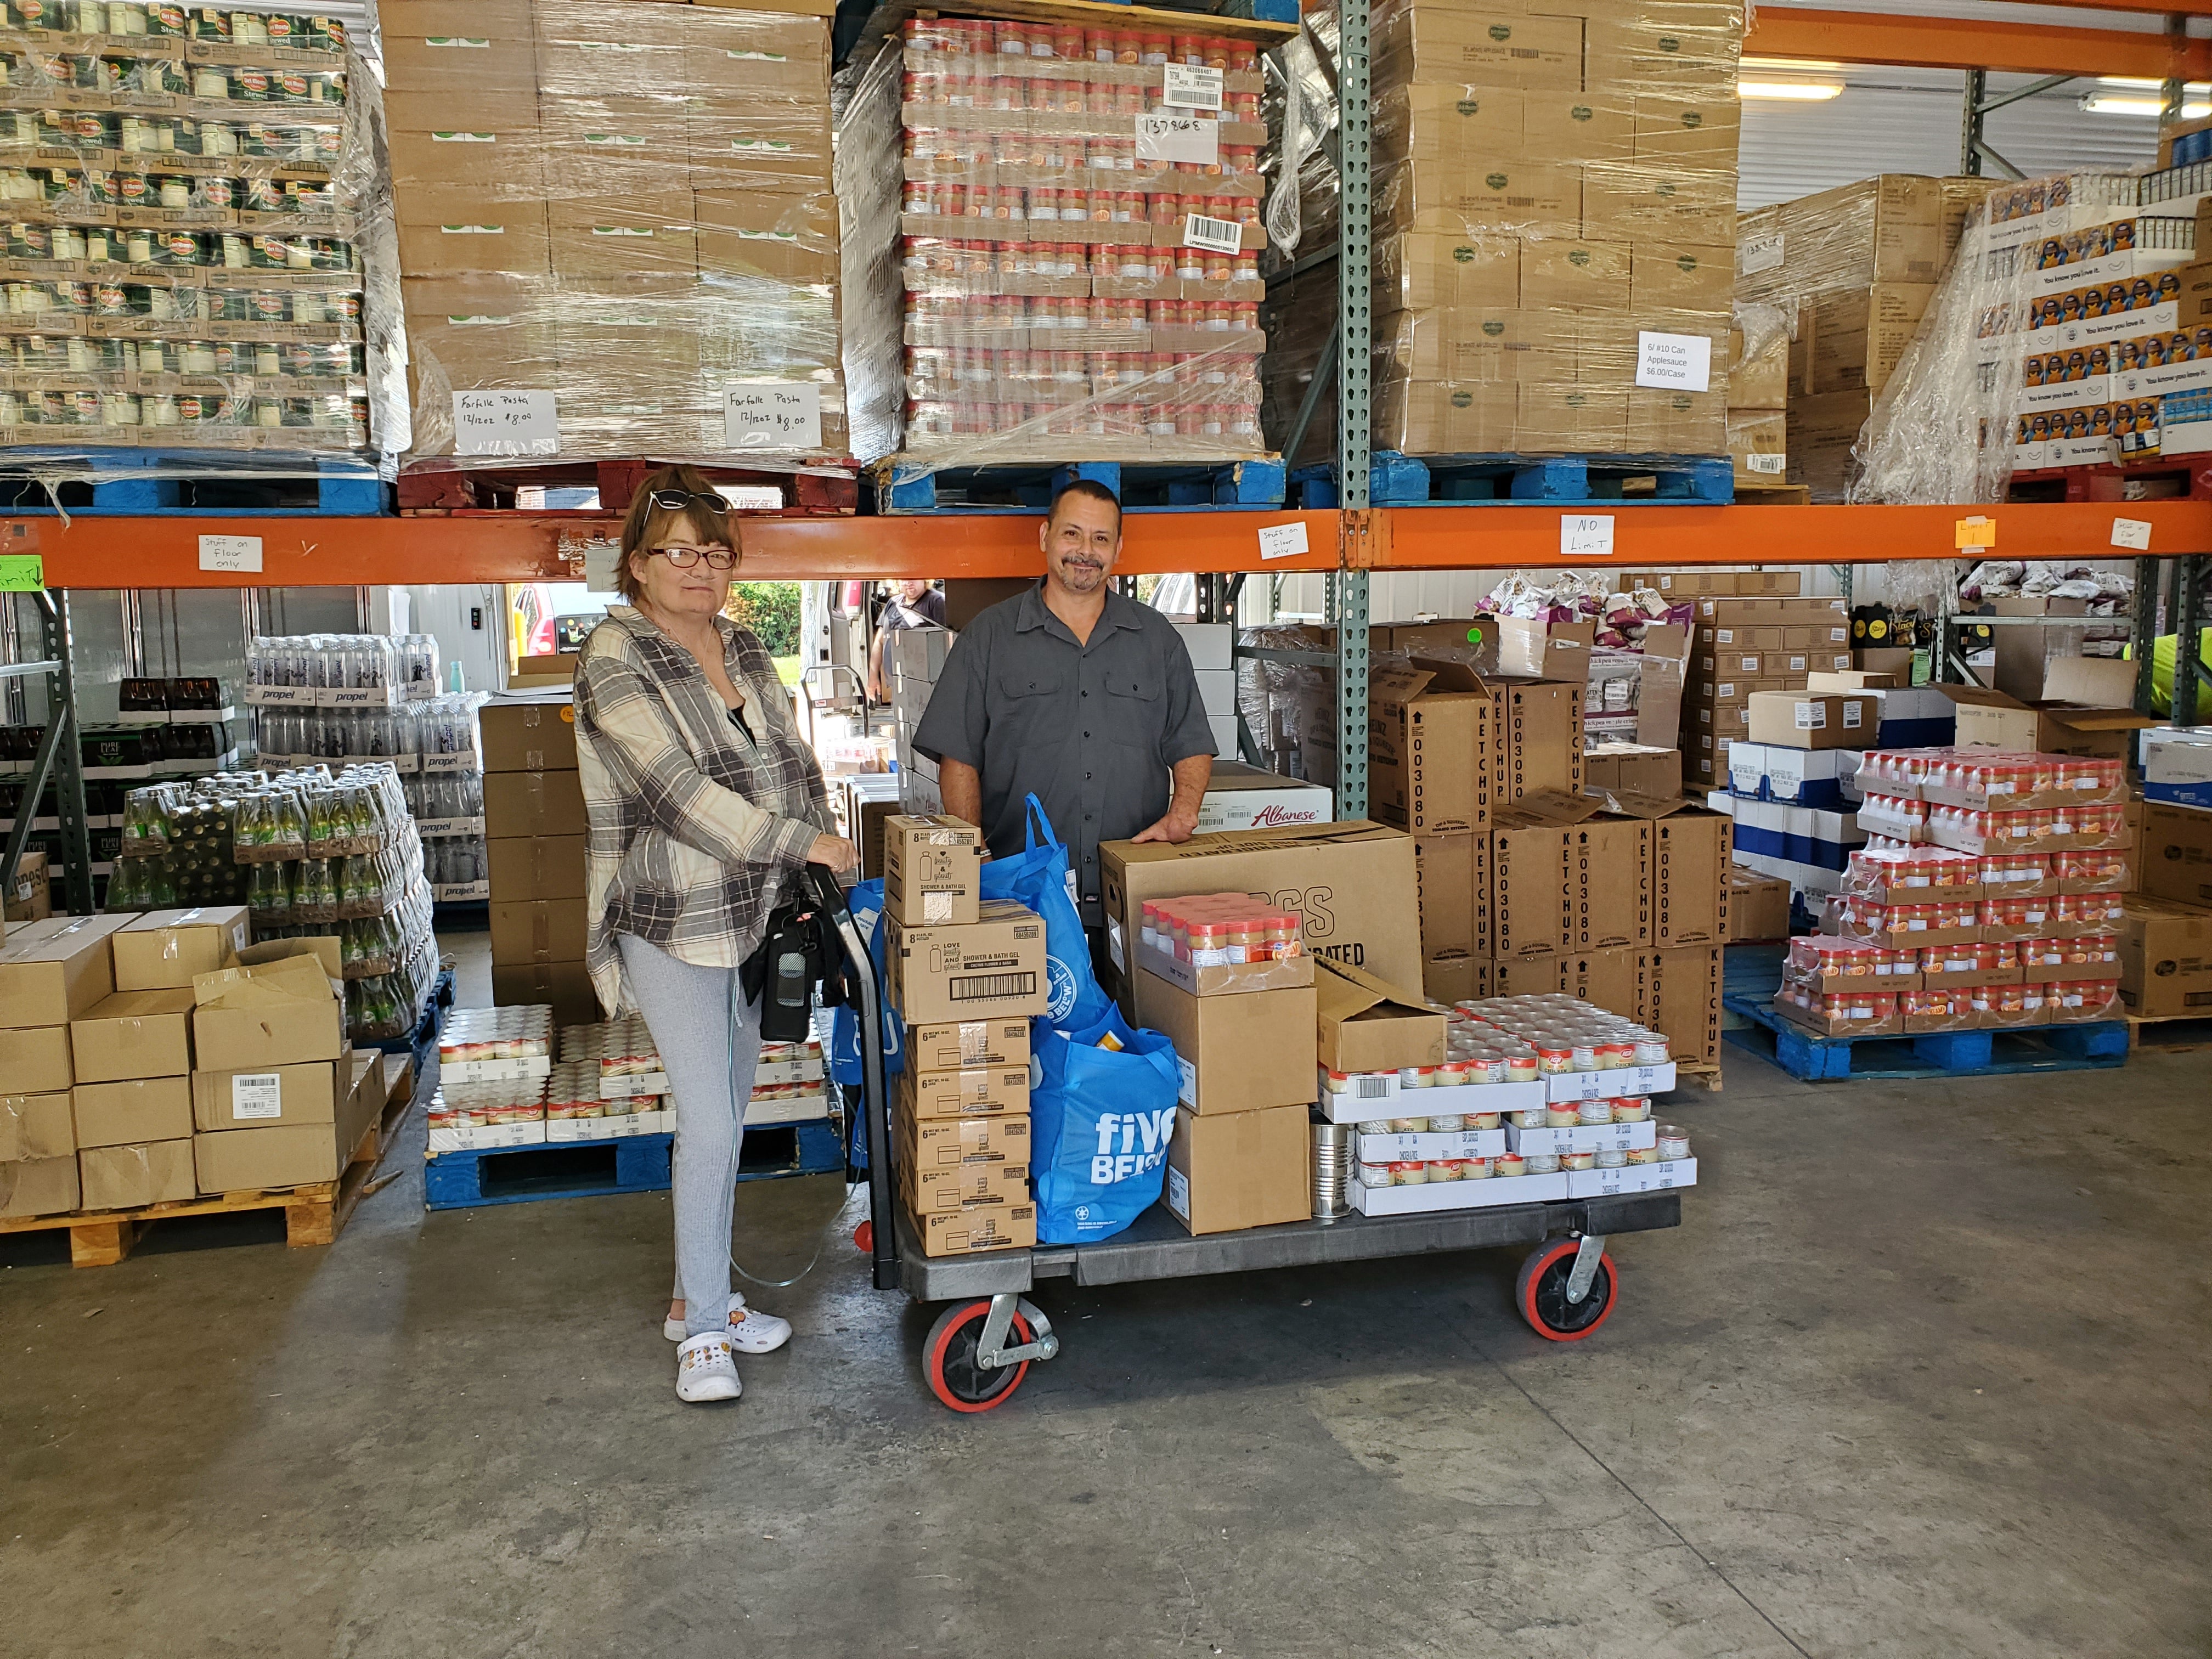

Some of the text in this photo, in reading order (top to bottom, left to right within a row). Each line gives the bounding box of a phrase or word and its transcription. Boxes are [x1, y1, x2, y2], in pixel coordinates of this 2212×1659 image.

[244, 91, 268, 99] Stewed
[2114, 323, 2125, 332] you
[1656, 345, 1669, 353] #10
[1671, 346, 1685, 354] Can
[1647, 356, 1688, 367] Applesauce
[1646, 367, 1686, 378] $6.00/Case
[2174, 374, 2186, 382] you
[730, 392, 800, 407] Farfalle Pasta
[2096, 445, 2108, 454] you
[1578, 519, 1598, 532] NO
[216, 560, 240, 569] only
[262, 690, 295, 700] propel
[335, 691, 368, 703] propel
[1494, 691, 1504, 797] KETCHUP
[1571, 690, 1579, 794] KETCHUP
[261, 757, 291, 768] propel
[428, 756, 458, 767] propel
[1514, 718, 1523, 798] 003080
[1478, 706, 1487, 823] KETCHUP
[1414, 738, 1423, 827] 003080
[1250, 805, 1317, 827] Albanese
[420, 822, 451, 833] propel
[913, 833, 919, 842] 8
[1719, 823, 1728, 934] KETCHUP
[445, 886, 475, 896] propel
[1477, 838, 1486, 950] KETCHUP
[1562, 832, 1571, 945] KETCHUP
[1580, 858, 1588, 943] 003080
[1500, 864, 1509, 950] 003080
[910, 934, 916, 944] 8
[1708, 949, 1718, 1057] KETCHUP
[922, 1032, 928, 1041] 6
[922, 1080, 927, 1088] 6
[922, 1130, 928, 1139] 6
[923, 1174, 928, 1183] 6
[931, 1218, 936, 1227] 6
